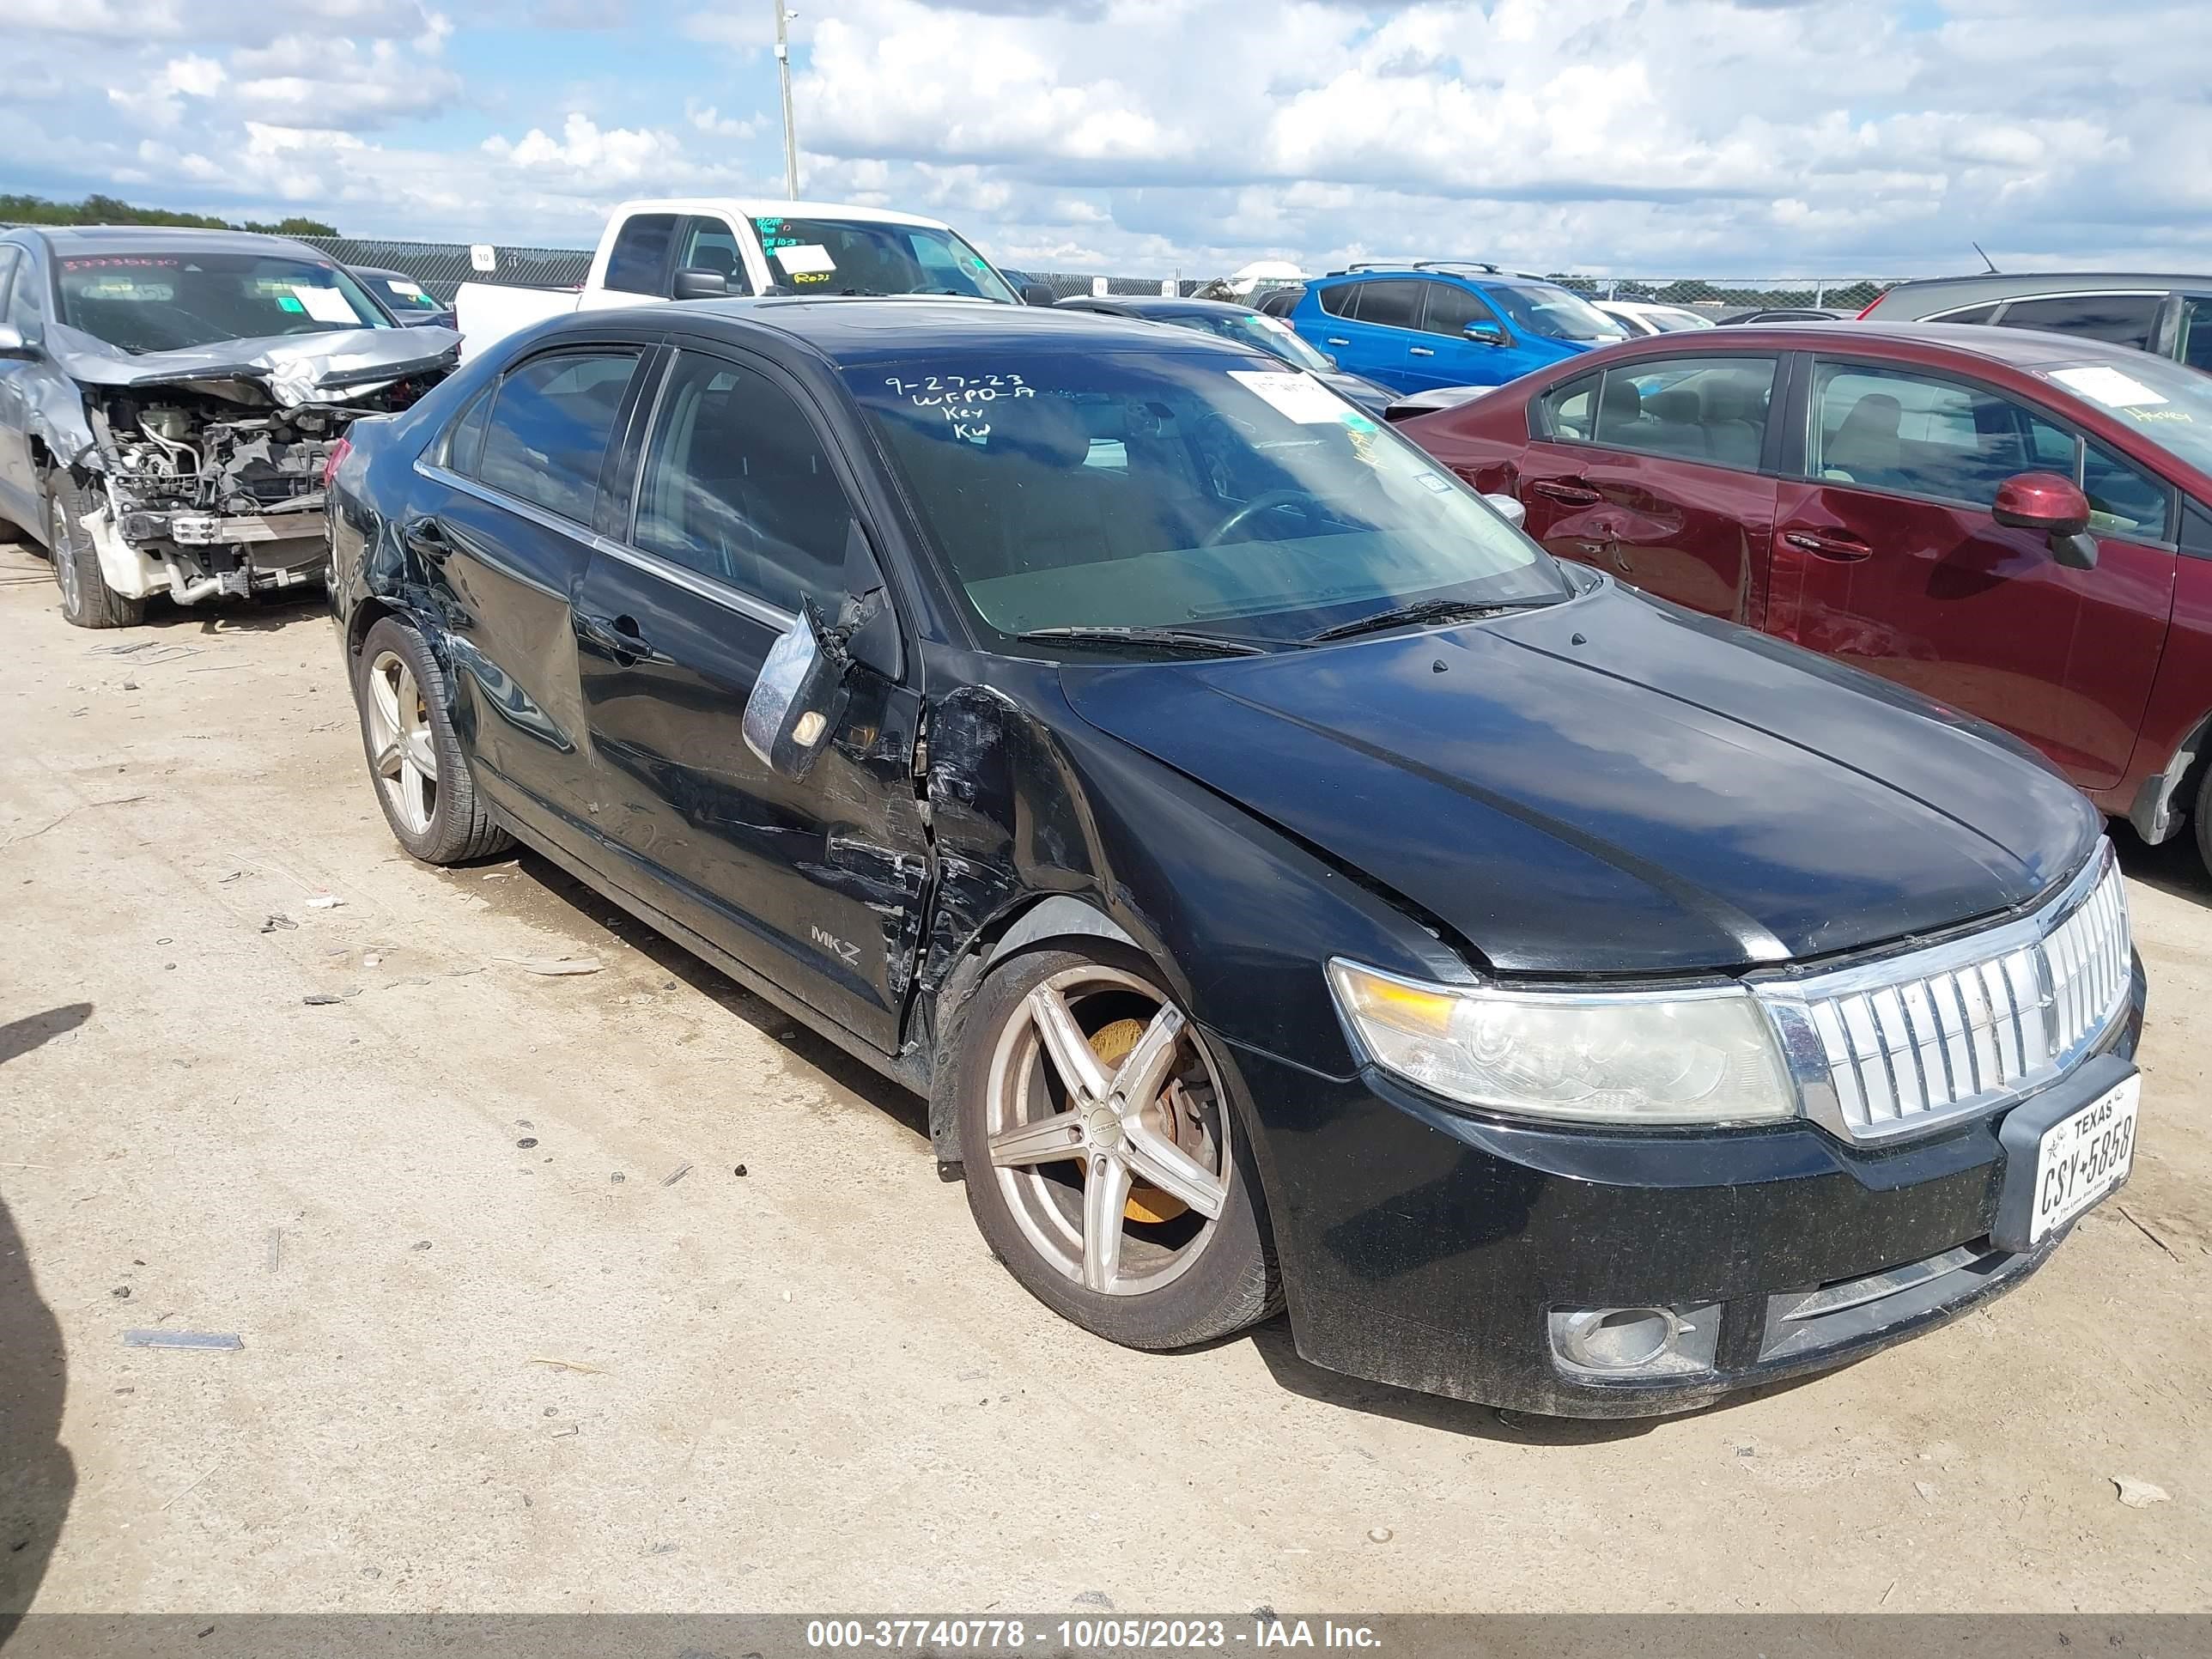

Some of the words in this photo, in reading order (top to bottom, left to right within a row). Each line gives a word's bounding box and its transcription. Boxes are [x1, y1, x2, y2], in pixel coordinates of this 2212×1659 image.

[885, 374, 1024, 395] 9-27-23
[941, 406, 983, 421] Key
[811, 925, 861, 966] MKZ
[2075, 1099, 2112, 1139] TEXAS
